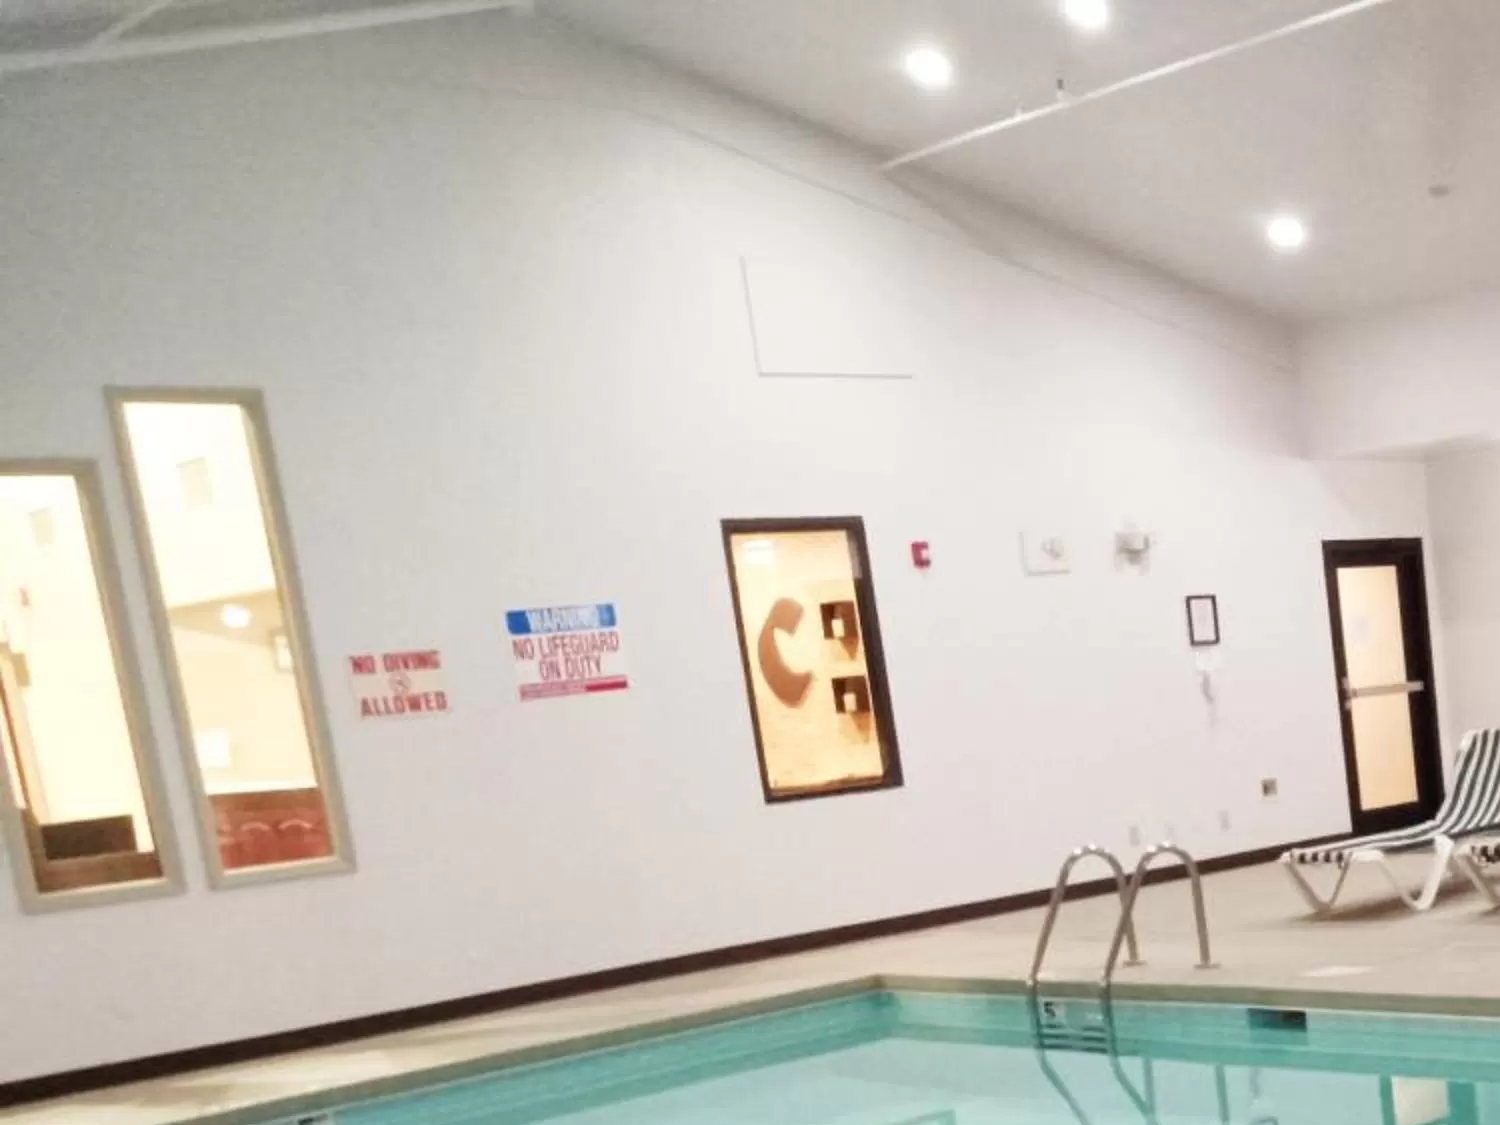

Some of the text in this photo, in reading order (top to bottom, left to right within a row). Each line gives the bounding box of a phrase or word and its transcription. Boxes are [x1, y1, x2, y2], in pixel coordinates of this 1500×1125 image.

[512, 631, 619, 660] NO LIFEGUARD
[349, 649, 441, 674] NO DIVING
[539, 655, 602, 681] ON DUTY
[361, 691, 448, 717] ALLOWED
